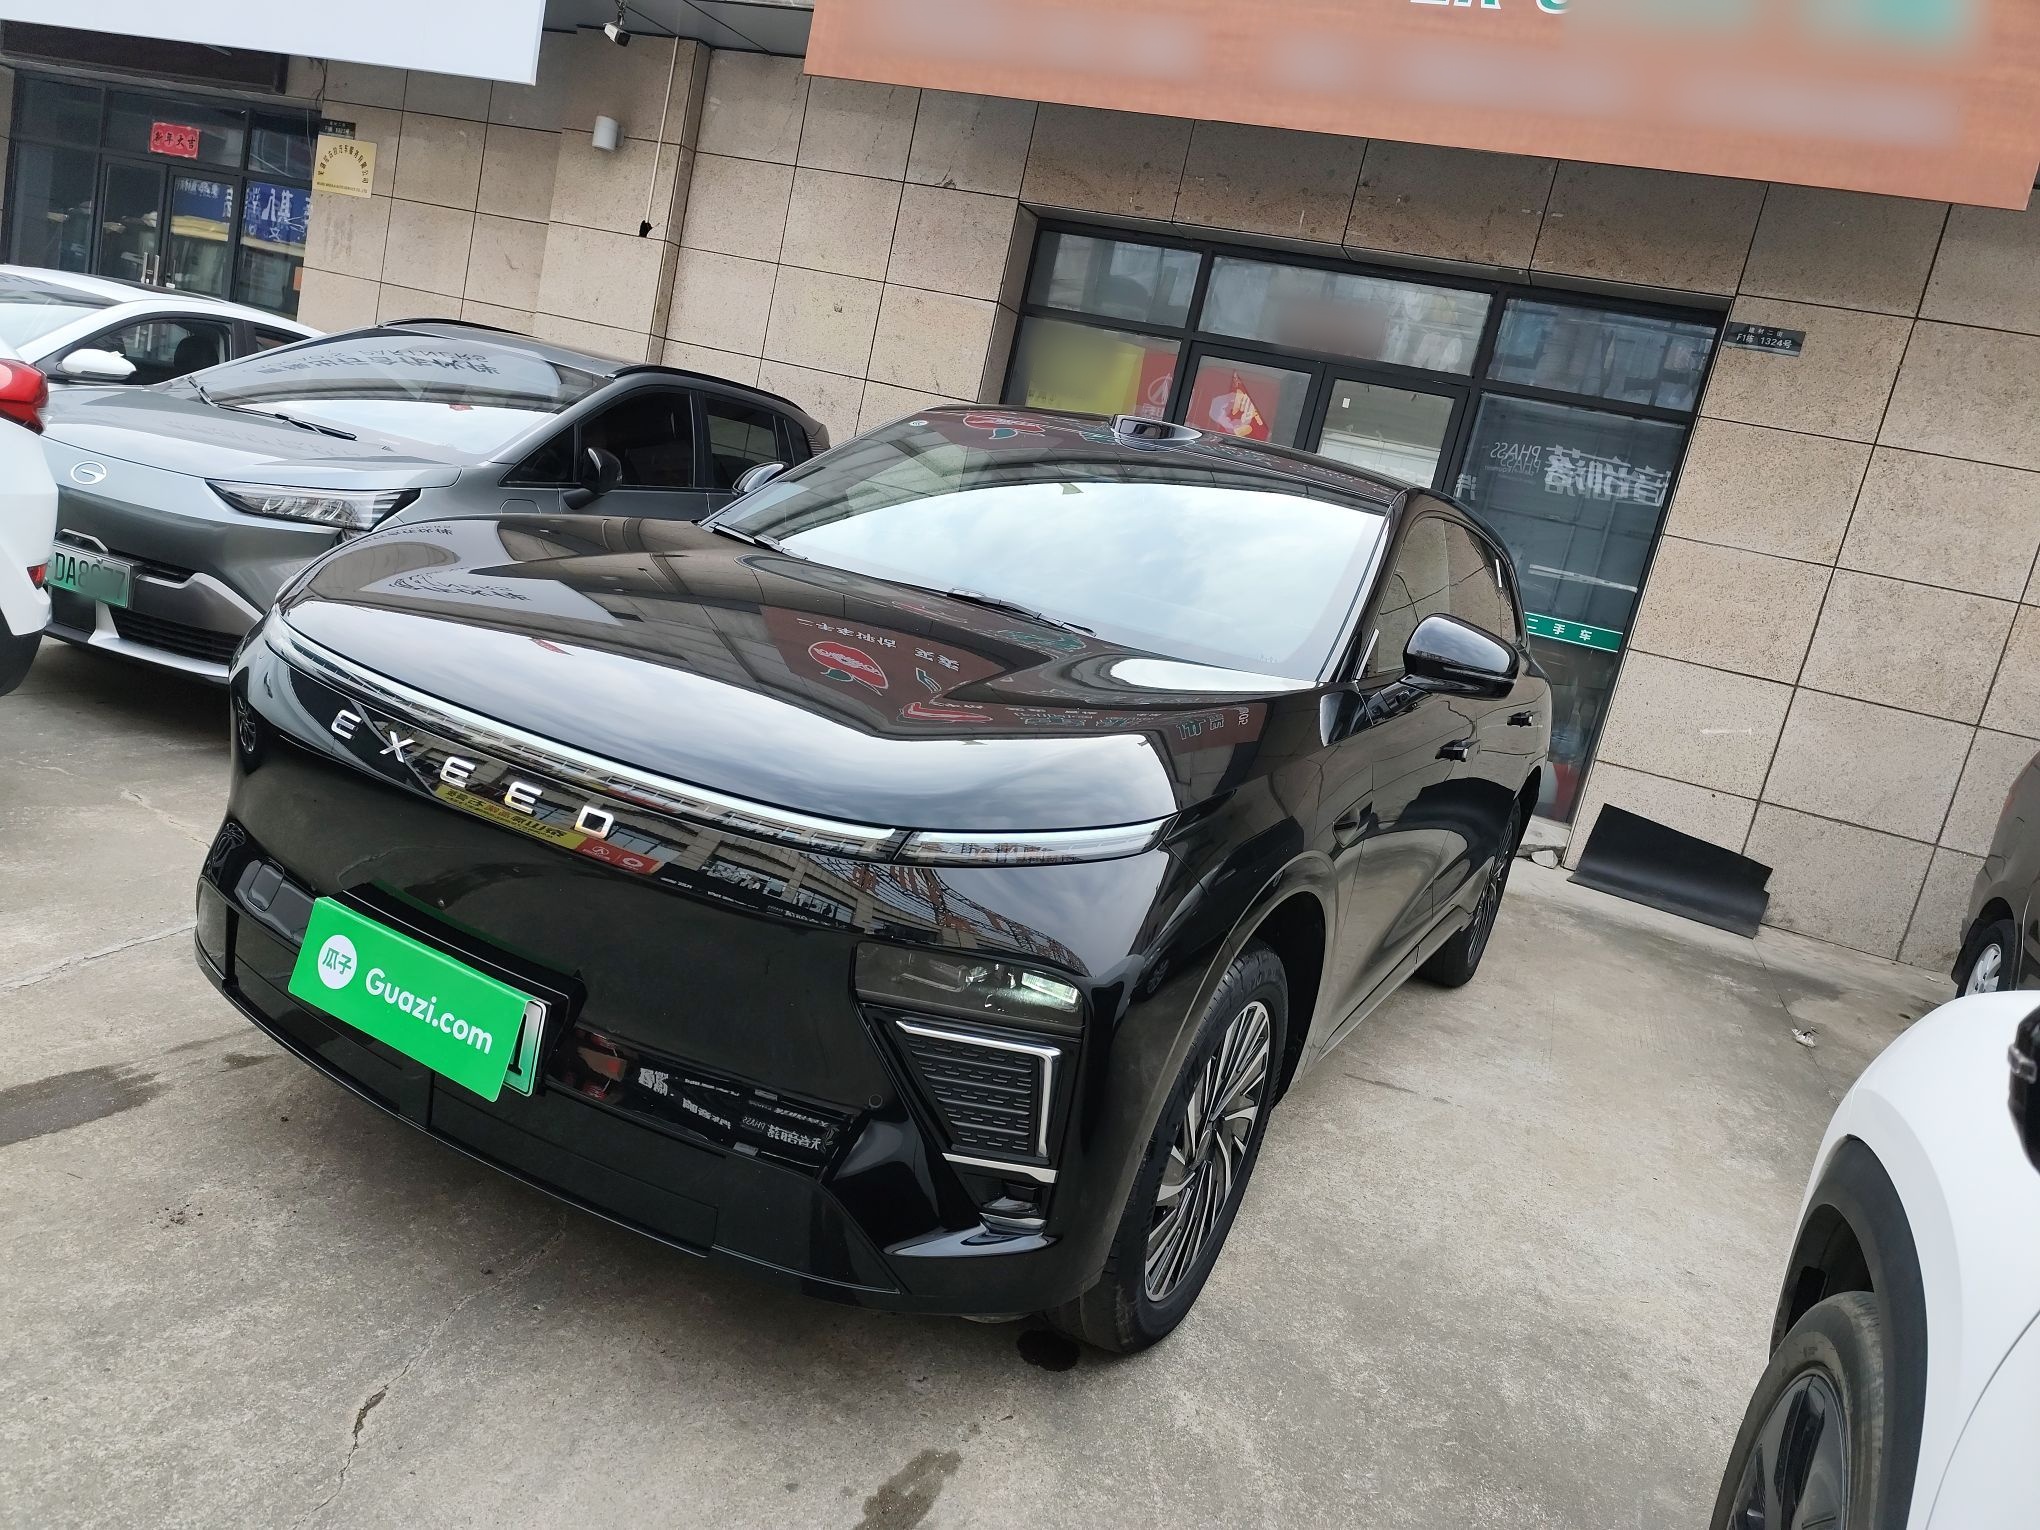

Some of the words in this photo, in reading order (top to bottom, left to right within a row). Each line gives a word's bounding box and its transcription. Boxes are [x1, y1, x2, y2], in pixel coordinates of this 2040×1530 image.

[153, 131, 196, 150] 新年大吉
[1760, 337, 1792, 349] 1324号
[1526, 618, 1593, 641] 二手车
[331, 709, 615, 839] EXEED
[322, 949, 352, 976] 瓜子
[366, 967, 493, 1055] Guazi.com
